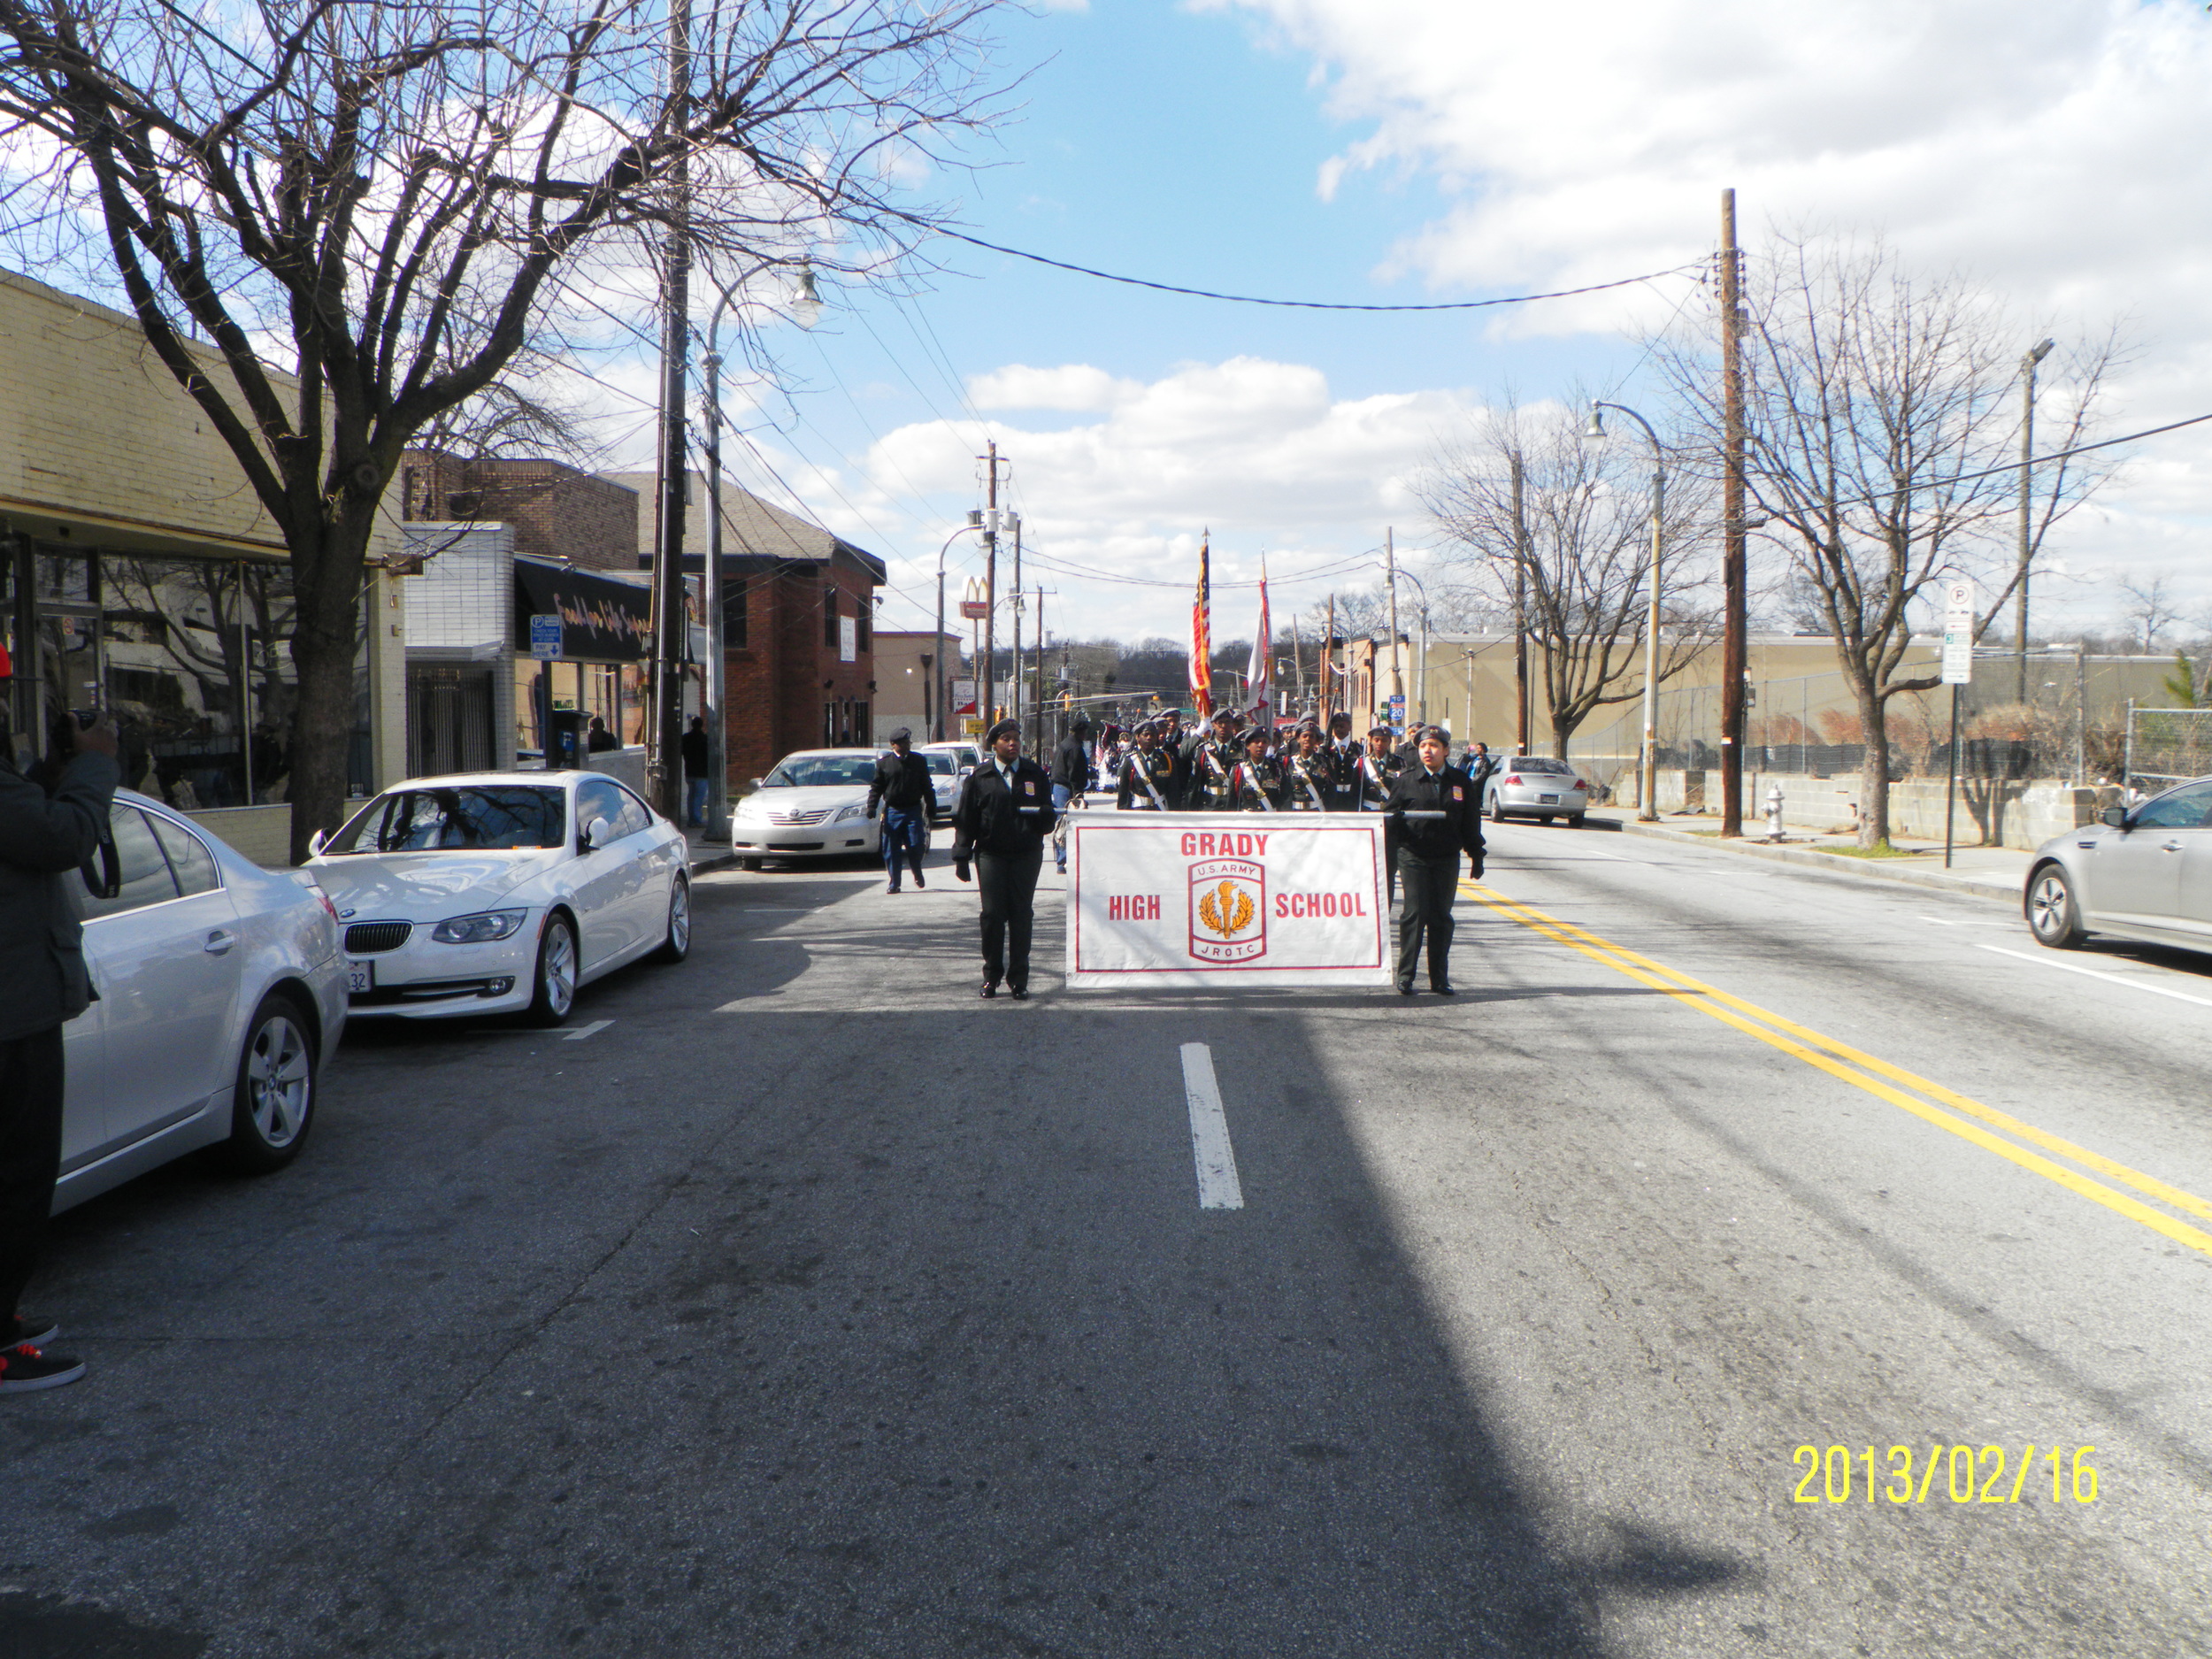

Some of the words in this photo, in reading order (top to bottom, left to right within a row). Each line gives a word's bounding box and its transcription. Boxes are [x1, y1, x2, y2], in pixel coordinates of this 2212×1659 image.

[1181, 833, 1269, 856] GRADY
[1197, 864, 1218, 876] U.S.
[1220, 864, 1256, 875] ARMY
[1109, 895, 1161, 920] HIGH
[1275, 892, 1367, 918] SCHOOL
[1201, 944, 1255, 956] JROTC
